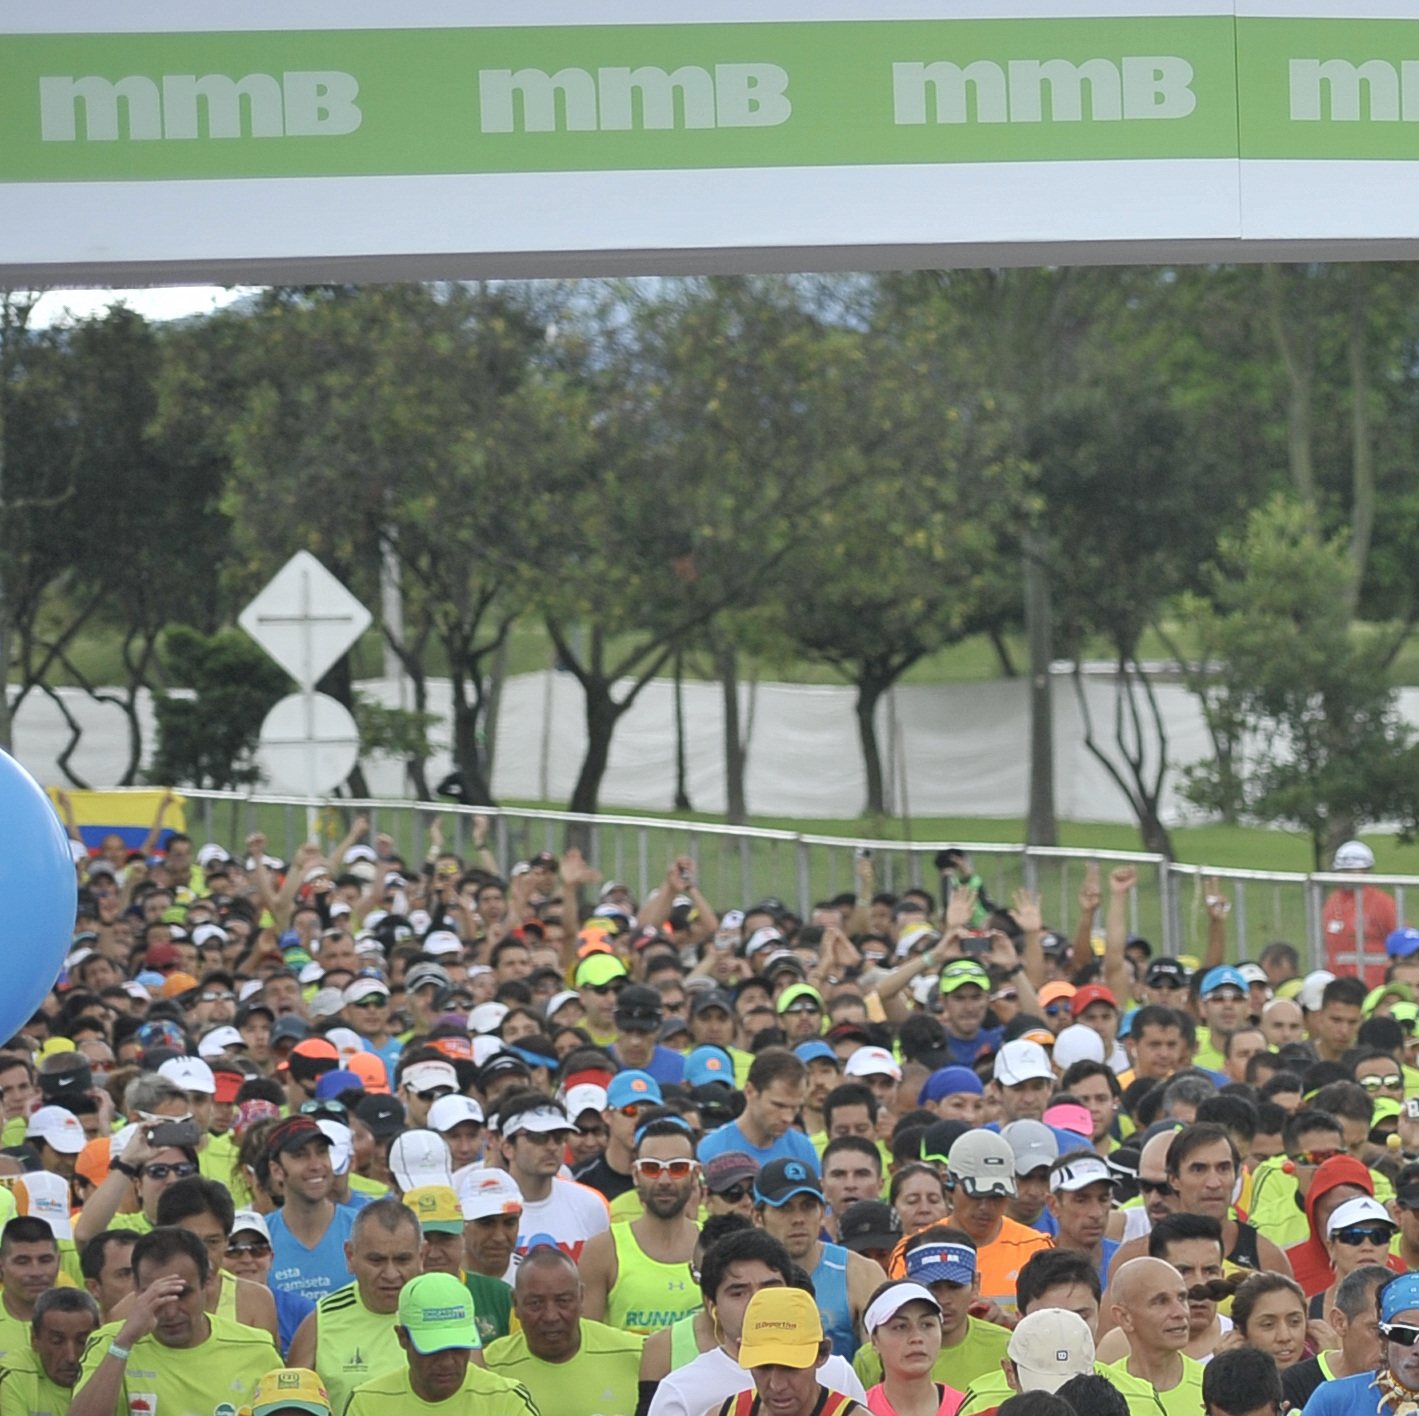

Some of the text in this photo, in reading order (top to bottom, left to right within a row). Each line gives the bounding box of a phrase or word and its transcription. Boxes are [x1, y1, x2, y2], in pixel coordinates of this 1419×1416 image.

[38, 69, 363, 142] mmB
[479, 61, 792, 133] mmB
[891, 55, 1197, 125] mmB
[275, 1267, 300, 1280] esta
[277, 1276, 330, 1292] camiseta
